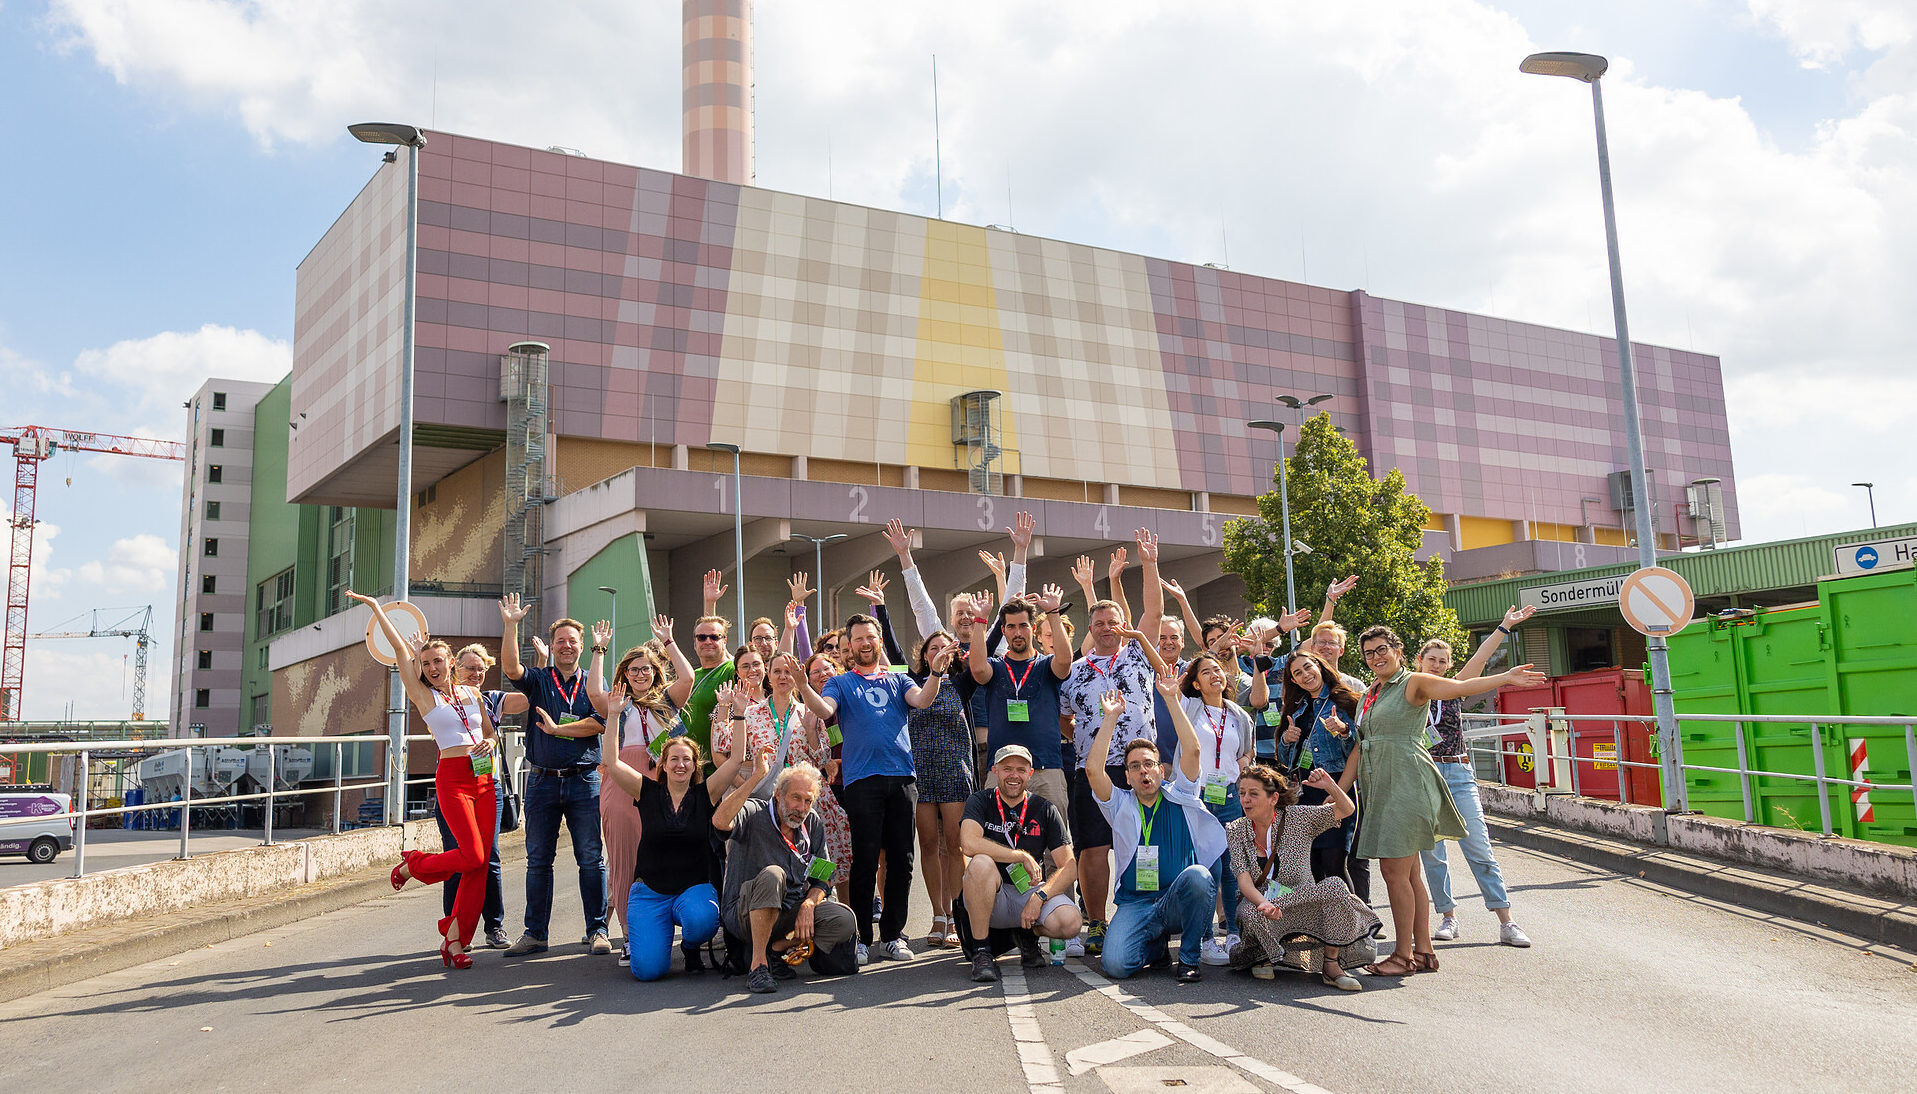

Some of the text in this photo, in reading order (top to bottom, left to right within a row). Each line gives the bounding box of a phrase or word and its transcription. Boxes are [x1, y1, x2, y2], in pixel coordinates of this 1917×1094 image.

[64, 432, 95, 443] WOLFF
[714, 475, 727, 514] 1
[849, 486, 870, 523] 2
[976, 496, 995, 532] 3
[1094, 504, 1111, 540] 4
[1201, 514, 1217, 546] 5
[1574, 543, 1587, 570] 8
